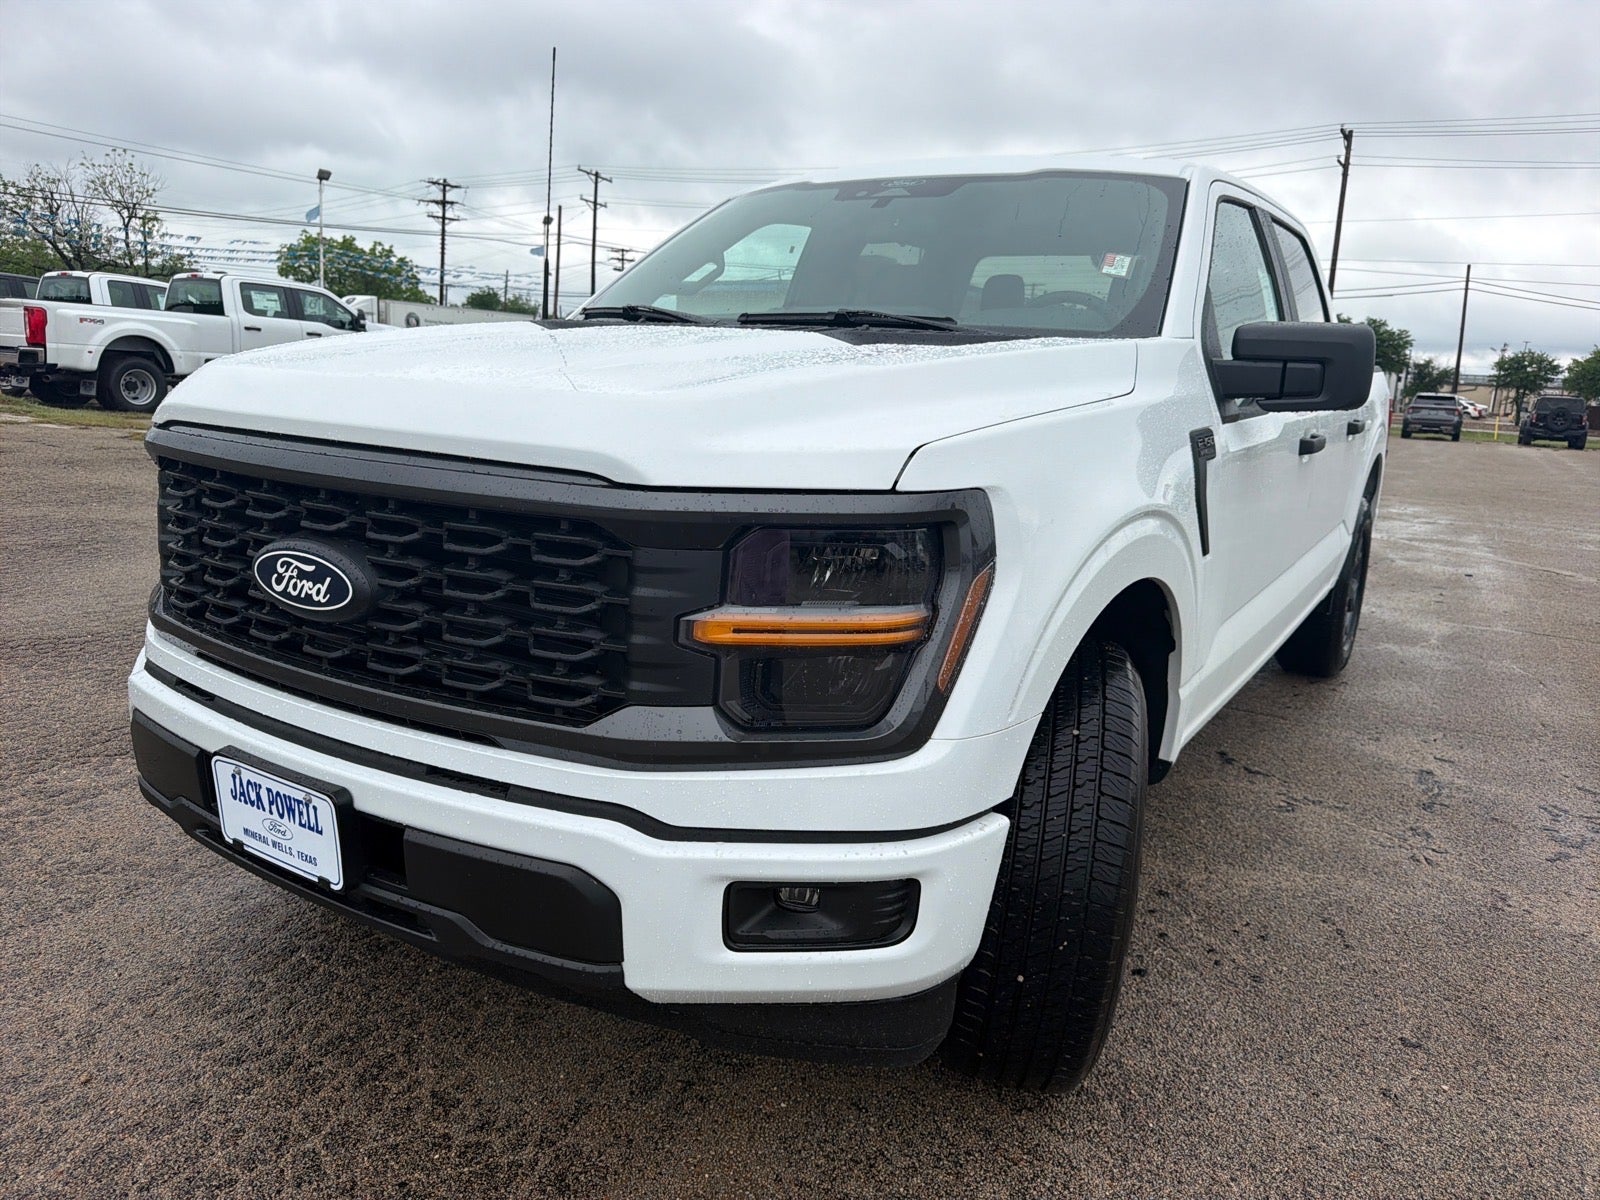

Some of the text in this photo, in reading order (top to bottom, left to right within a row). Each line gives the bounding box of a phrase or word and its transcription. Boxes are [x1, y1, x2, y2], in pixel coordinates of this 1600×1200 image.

[271, 557, 332, 603] Ford
[230, 773, 323, 836] JACK POWELL
[243, 826, 318, 867] MINERAL WELLS, TEXAS
[267, 820, 287, 837] Ford
